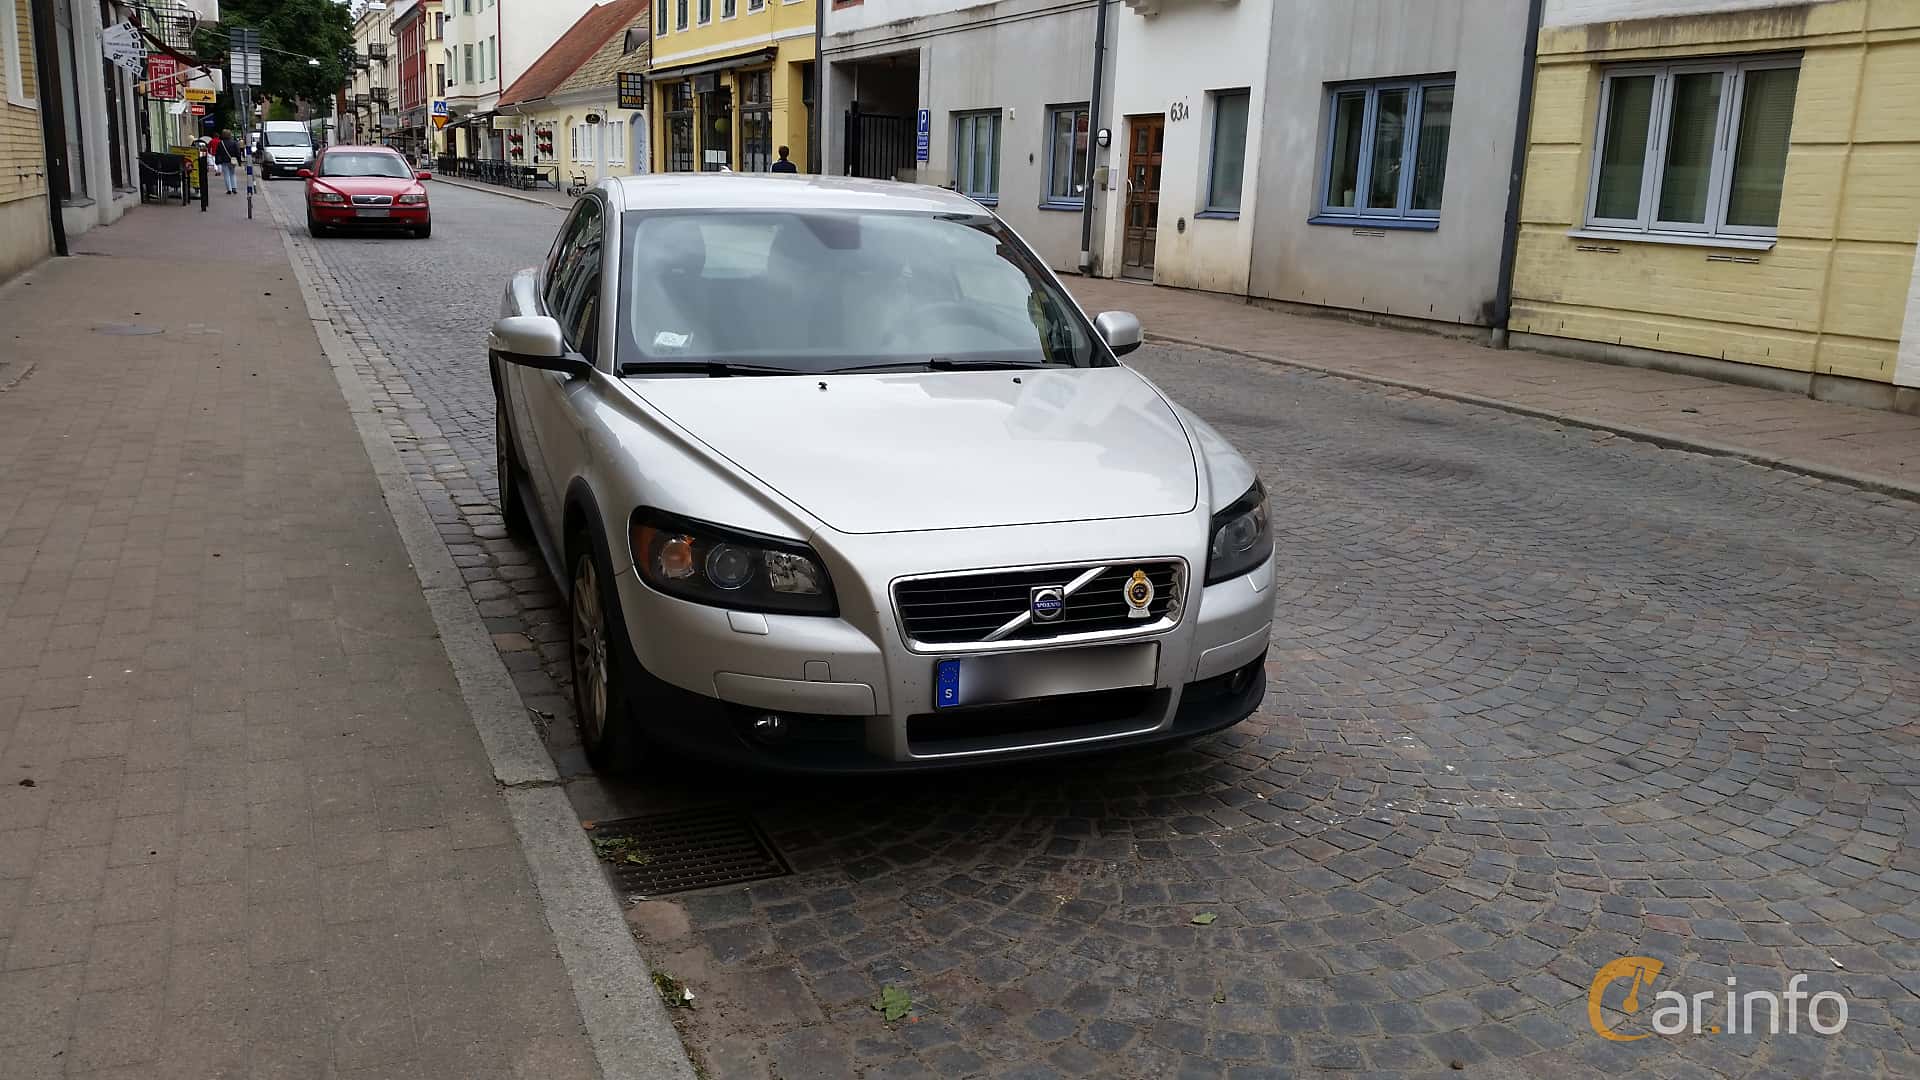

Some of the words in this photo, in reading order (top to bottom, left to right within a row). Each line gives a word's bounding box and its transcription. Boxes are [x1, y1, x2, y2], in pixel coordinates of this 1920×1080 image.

[622, 95, 641, 104] MM
[1170, 102, 1189, 122] 63A
[921, 111, 927, 131] P
[945, 689, 953, 699] S
